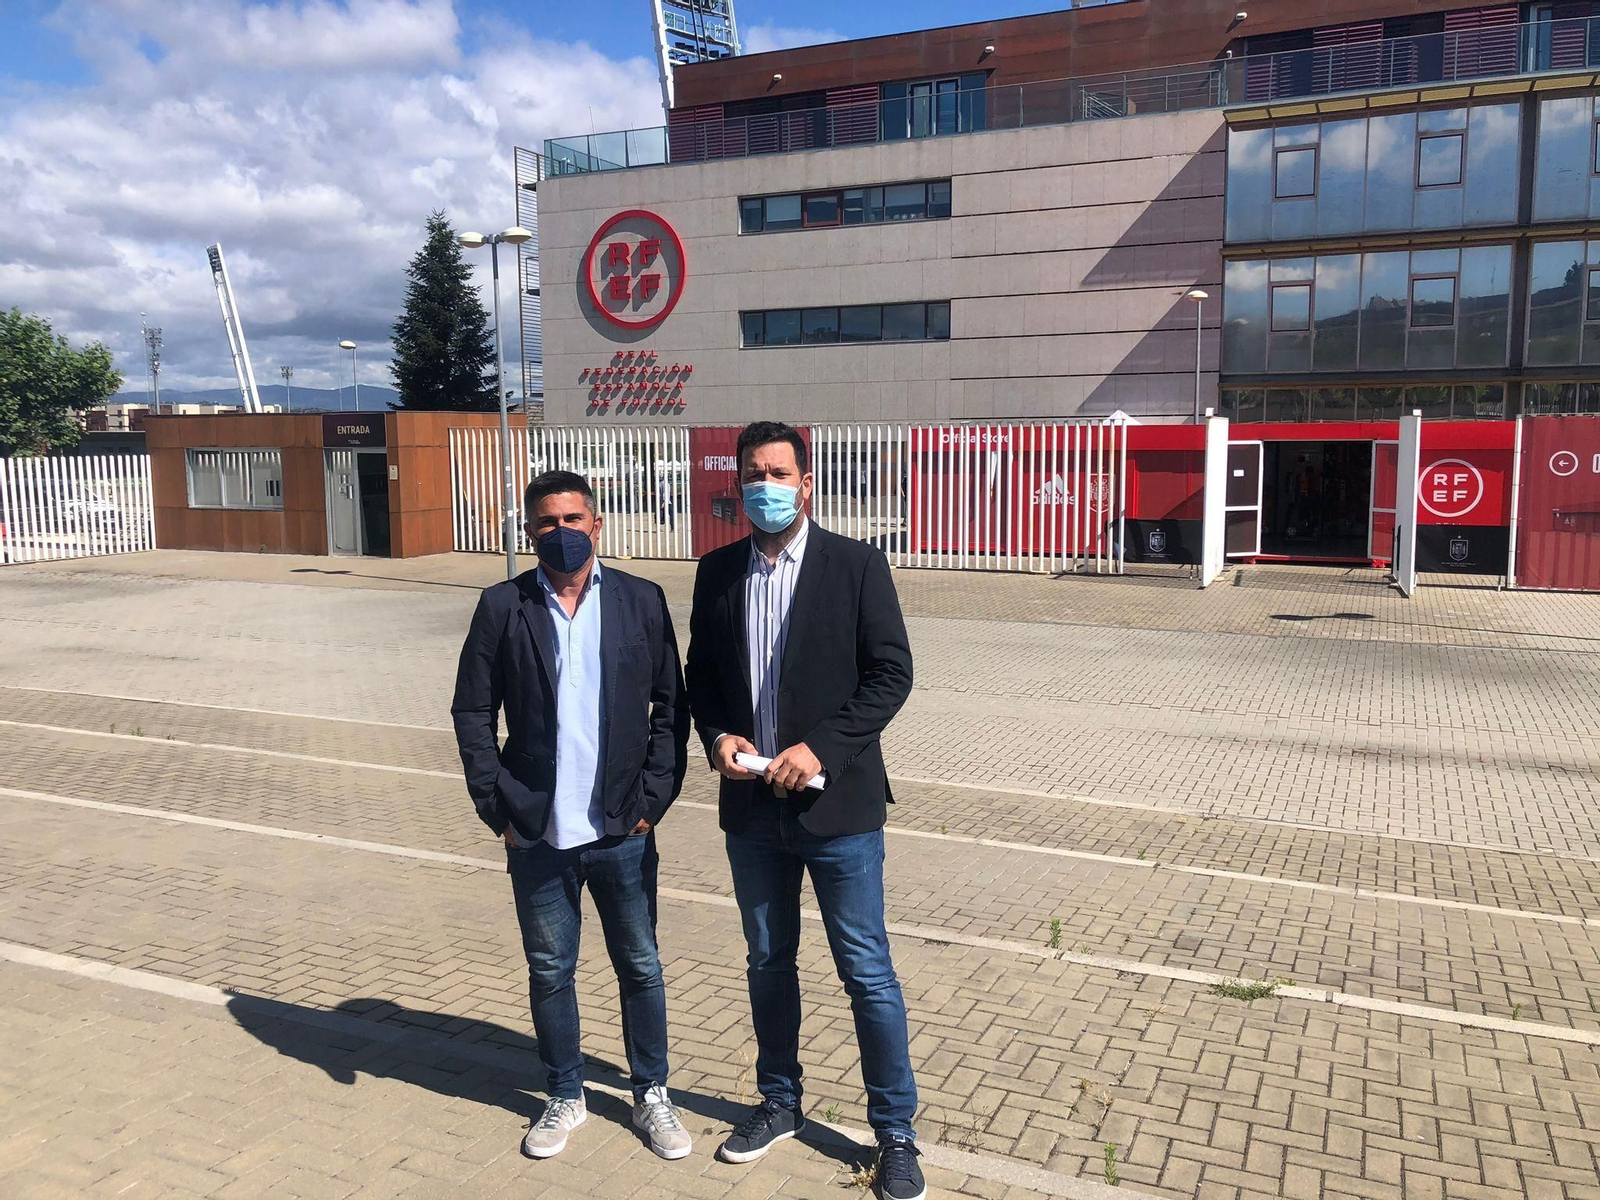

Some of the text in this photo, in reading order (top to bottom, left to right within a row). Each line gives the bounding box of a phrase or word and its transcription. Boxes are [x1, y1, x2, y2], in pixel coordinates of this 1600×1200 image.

[616, 350, 658, 359] REAL
[584, 362, 693, 375] FEDERACIÓN
[594, 380, 684, 391] ESPAÑOLA
[591, 397, 687, 408] DE FÚTBOL
[337, 425, 370, 434] ENTRADA
[942, 433, 979, 444] Ofica
[704, 455, 738, 471] OFFICIAL
